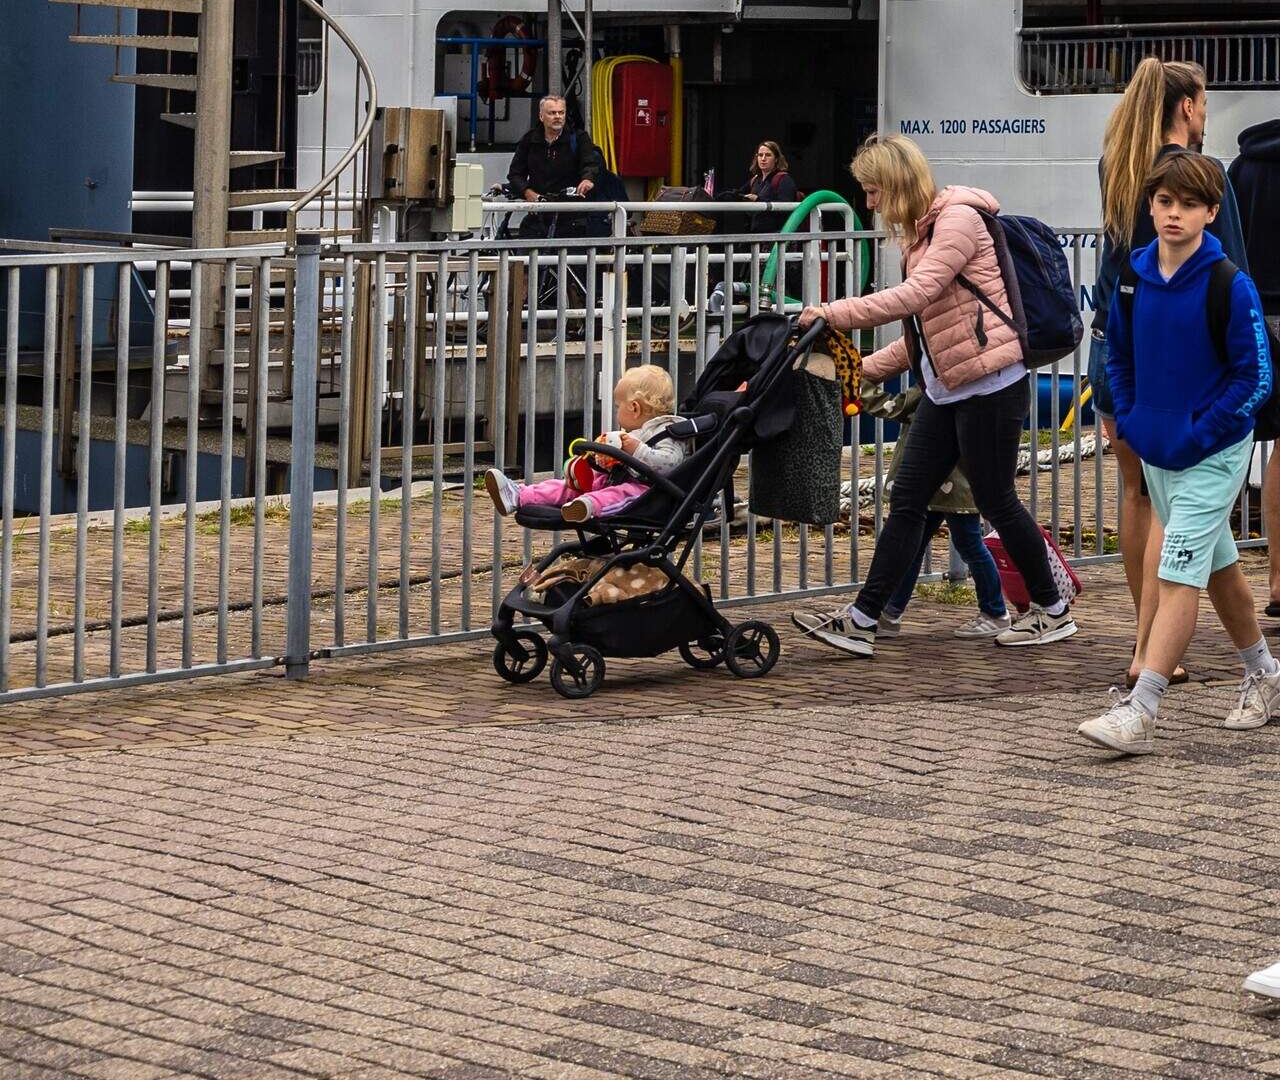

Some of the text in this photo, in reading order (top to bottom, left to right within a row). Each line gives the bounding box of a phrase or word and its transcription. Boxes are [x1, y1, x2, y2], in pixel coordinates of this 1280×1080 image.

[900, 119, 1046, 134] MAX. 1200 PASSAGIERS
